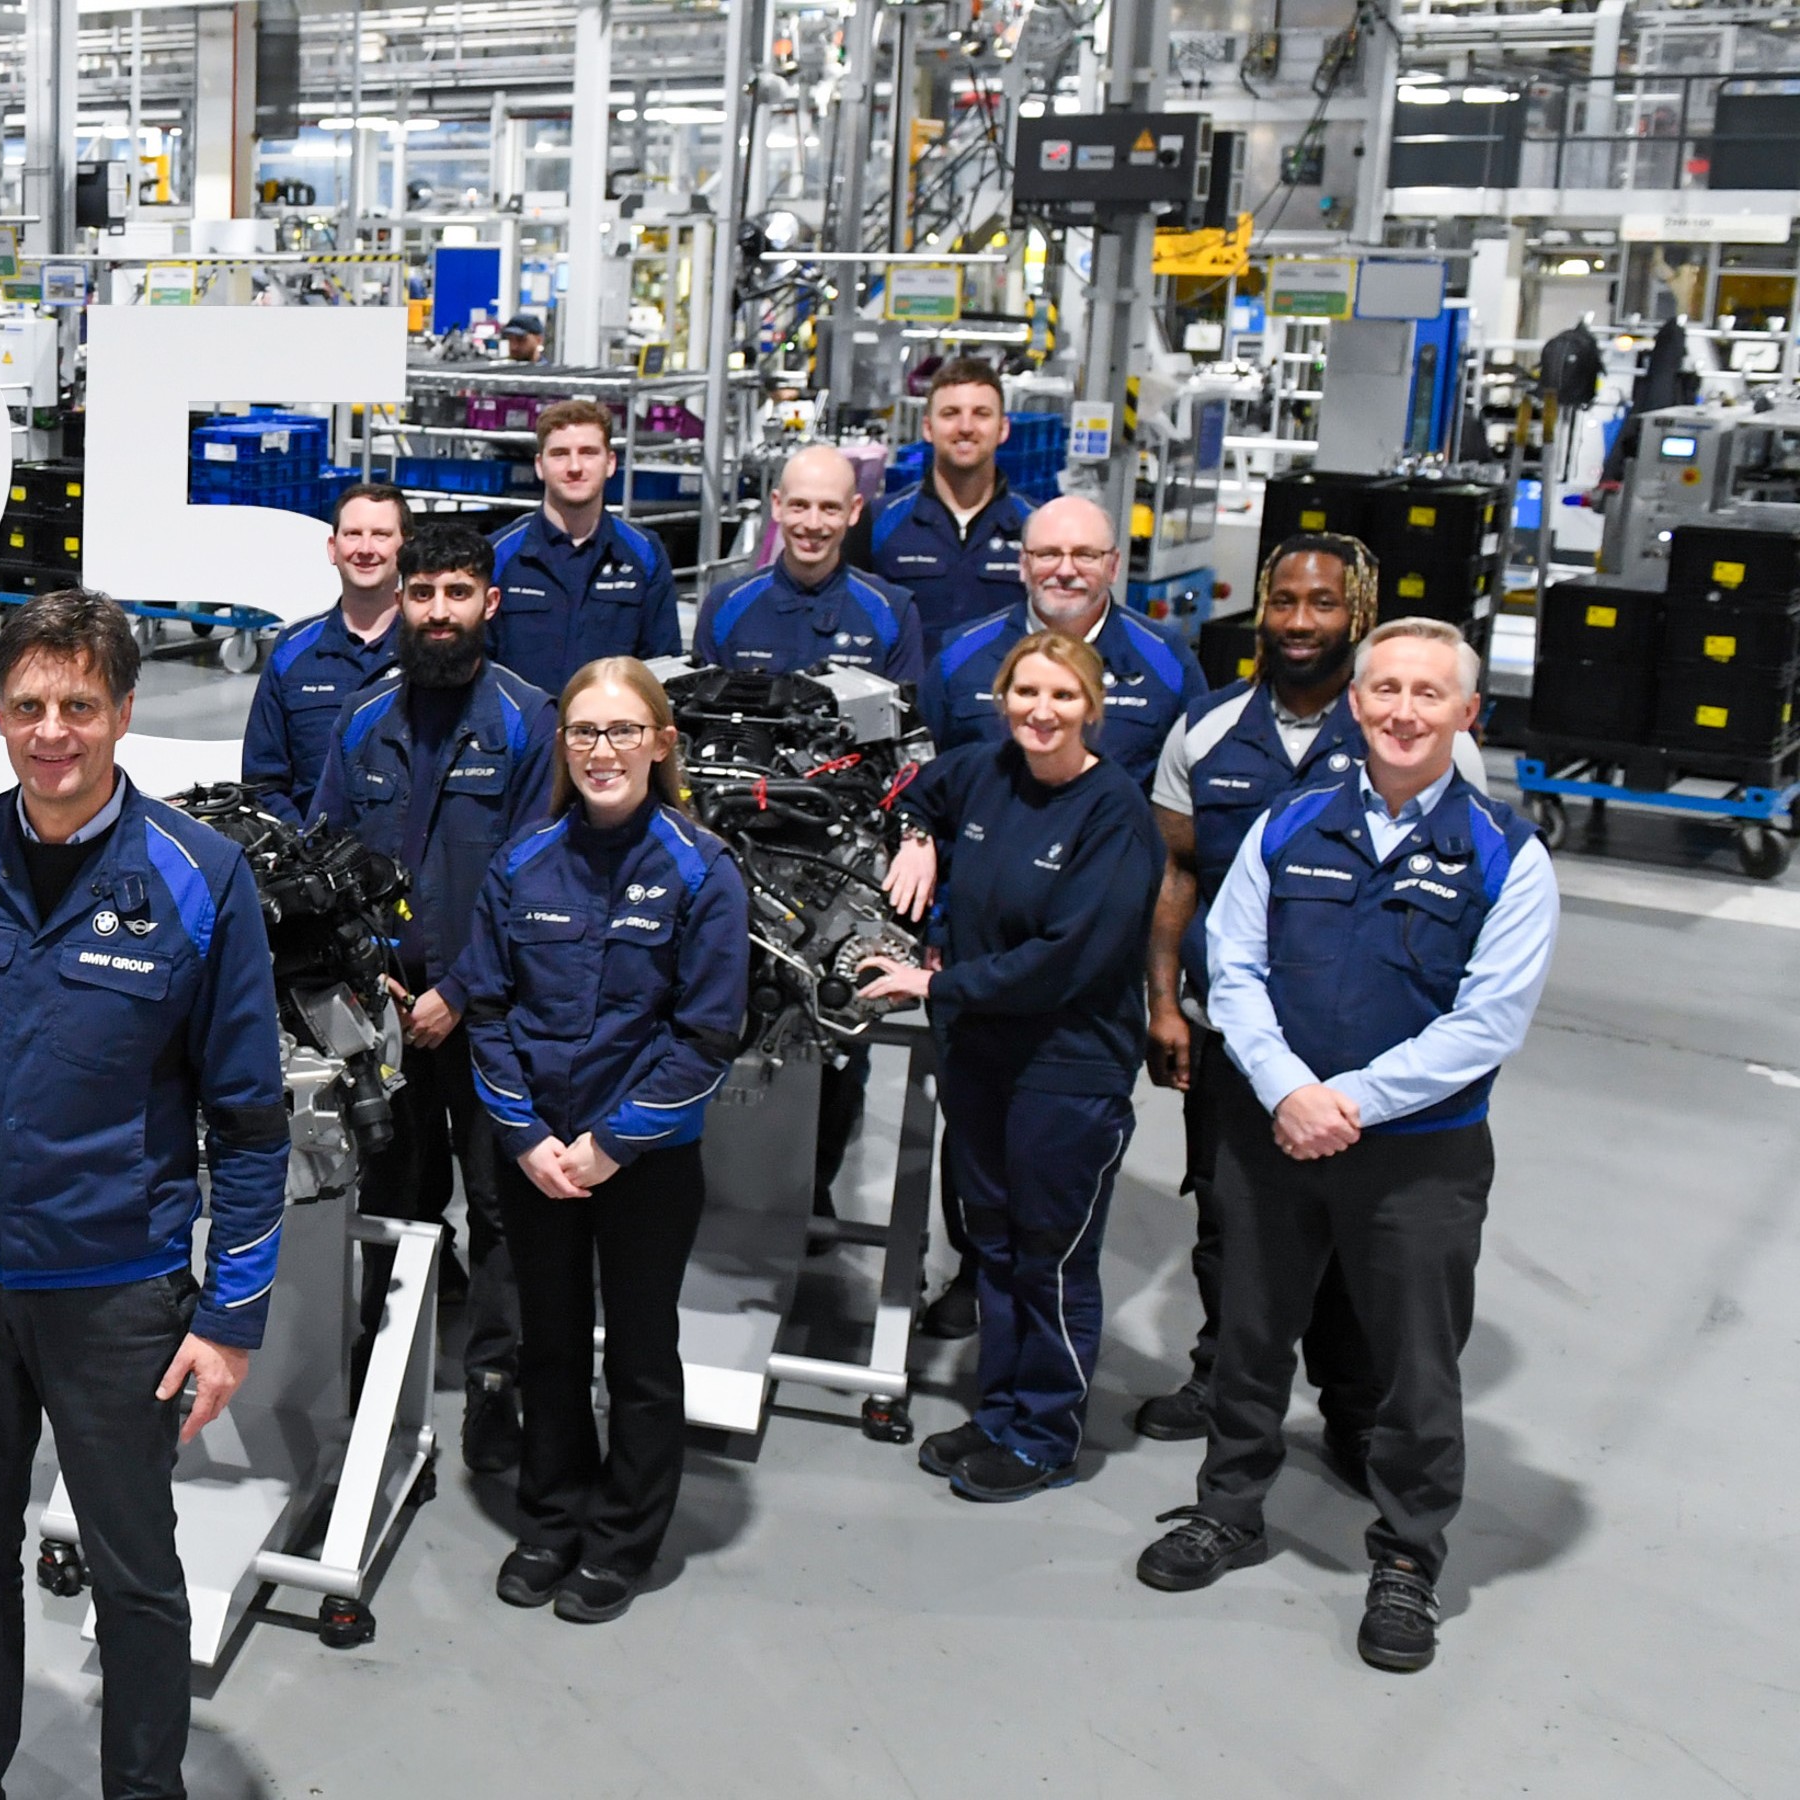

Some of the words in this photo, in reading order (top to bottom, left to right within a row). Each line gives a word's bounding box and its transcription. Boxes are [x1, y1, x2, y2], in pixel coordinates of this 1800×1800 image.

[449, 769, 464, 777] MW
[464, 767, 496, 777] GROUP
[1418, 880, 1458, 899] GROUP
[626, 916, 661, 931] GROUP
[78, 951, 112, 968] BMW
[111, 955, 156, 975] GROUP
